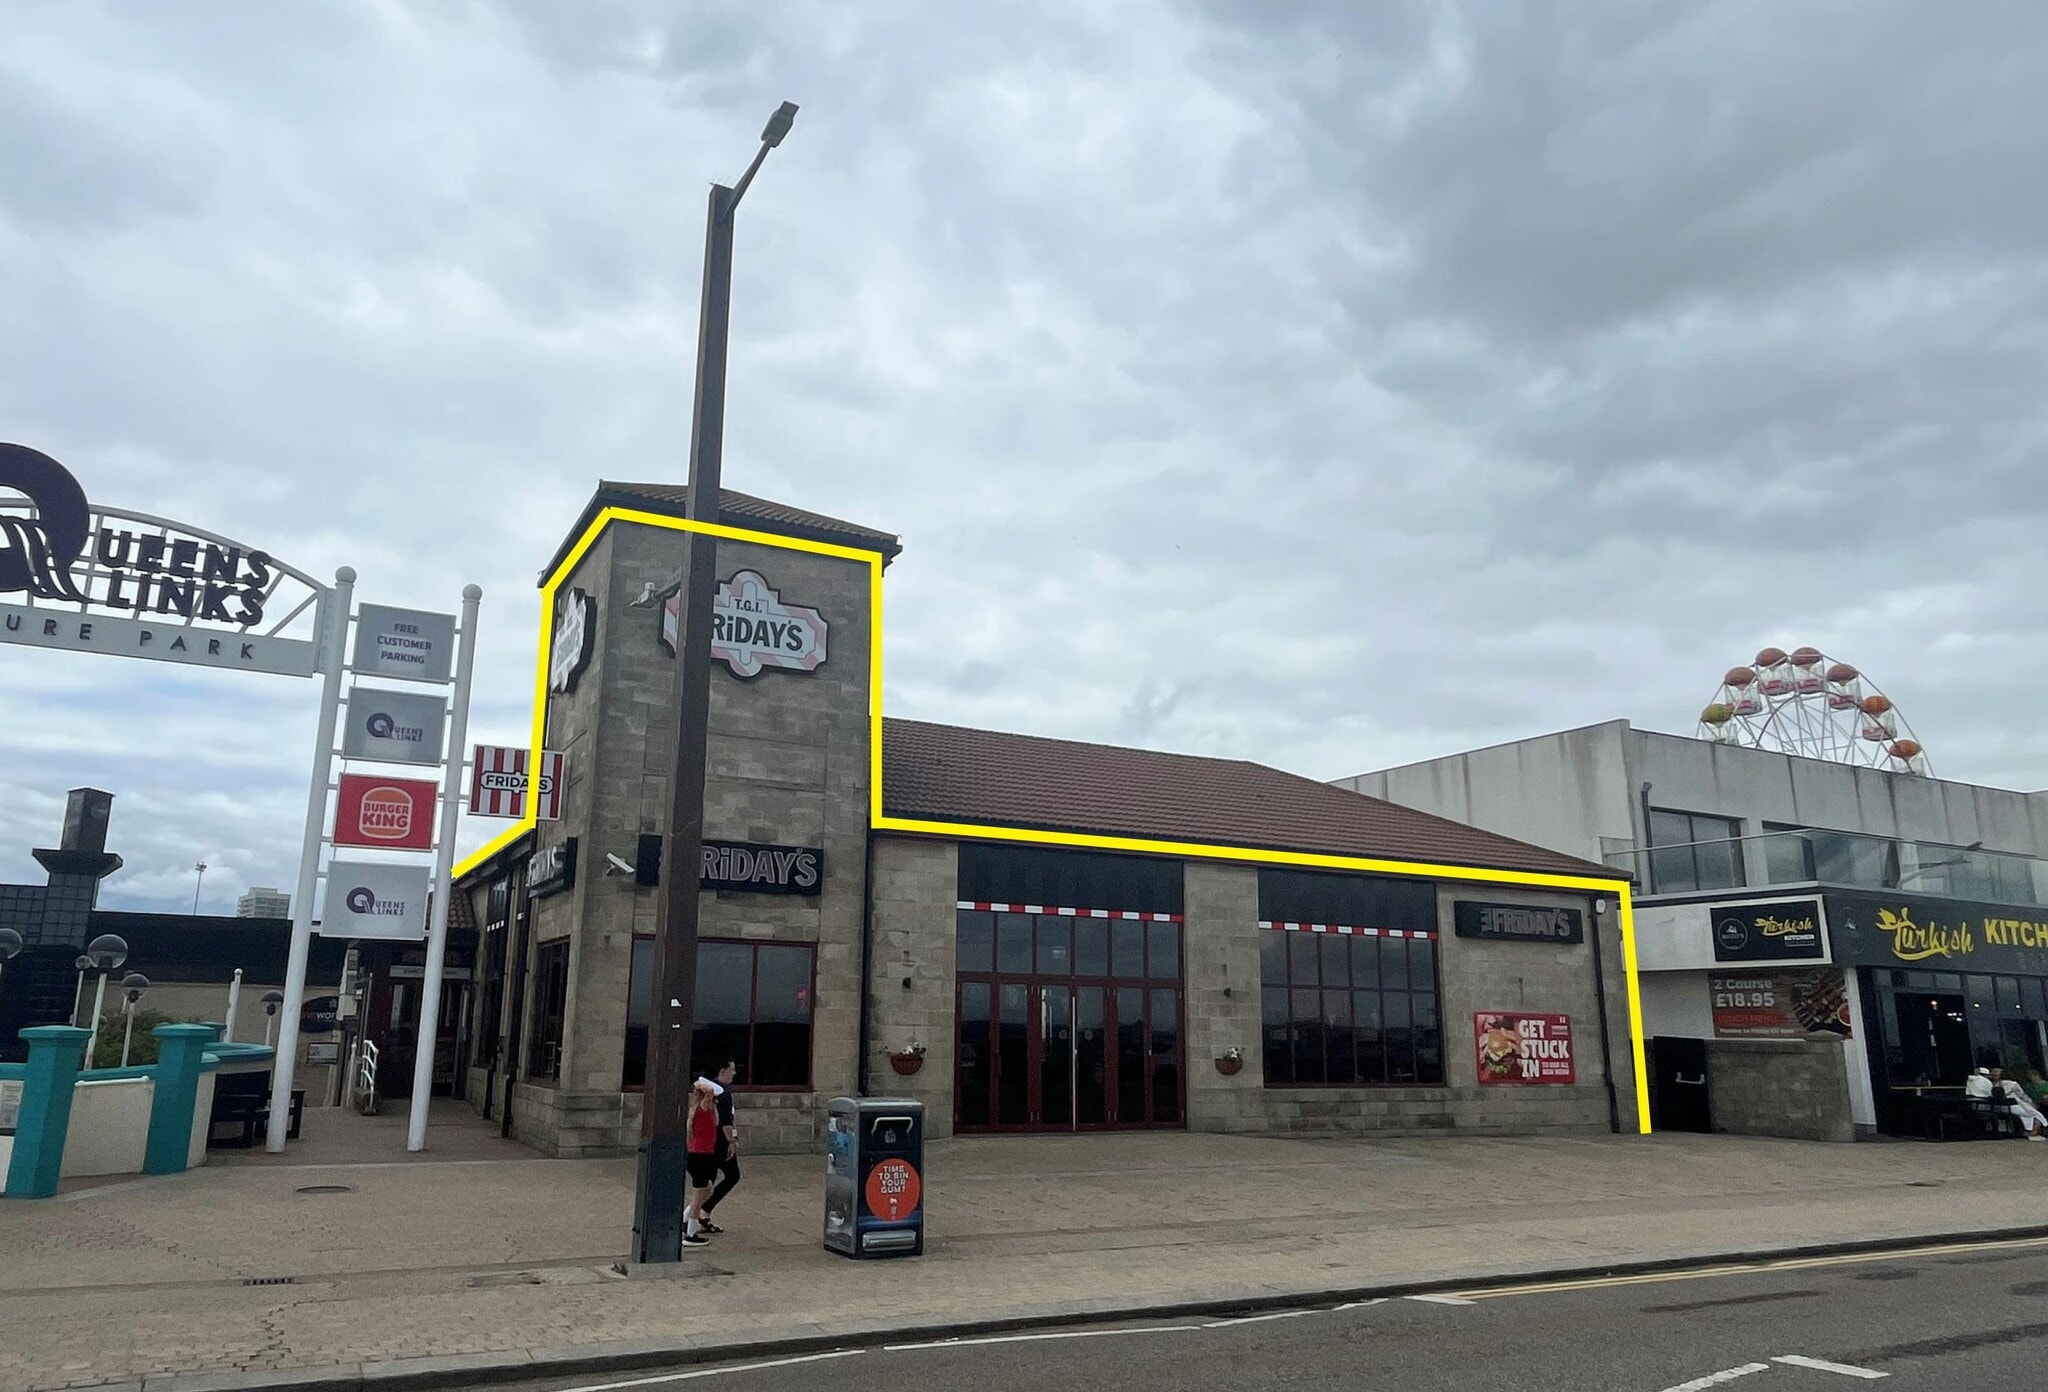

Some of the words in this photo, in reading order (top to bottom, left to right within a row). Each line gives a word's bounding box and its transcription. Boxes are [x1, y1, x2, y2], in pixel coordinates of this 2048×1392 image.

[106, 570, 265, 627] LINKS
[735, 599, 762, 613] T.G.I.
[394, 623, 419, 634] FREE
[712, 613, 803, 651] RiDAY'S
[139, 630, 254, 660] PARK
[377, 635, 432, 651] CUSTOMER
[381, 651, 425, 664] PARKING
[396, 733, 423, 743] LINKS
[486, 775, 548, 790] FRIDAS
[363, 803, 409, 815] BURGER
[362, 813, 408, 828] KING
[700, 846, 817, 887] RiDAY'S
[346, 887, 405, 915] QUEENS
[1754, 915, 1813, 936] Turkish
[1875, 906, 1974, 961] Turkish
[1714, 980, 1723, 990] 2
[1726, 979, 1773, 989] Course
[1716, 992, 1775, 1008] £18.95
[1519, 1019, 1545, 1038] GET
[1520, 1039, 1569, 1059] STUCK
[1521, 1059, 1540, 1077] IN
[878, 1172, 890, 1180] TO
